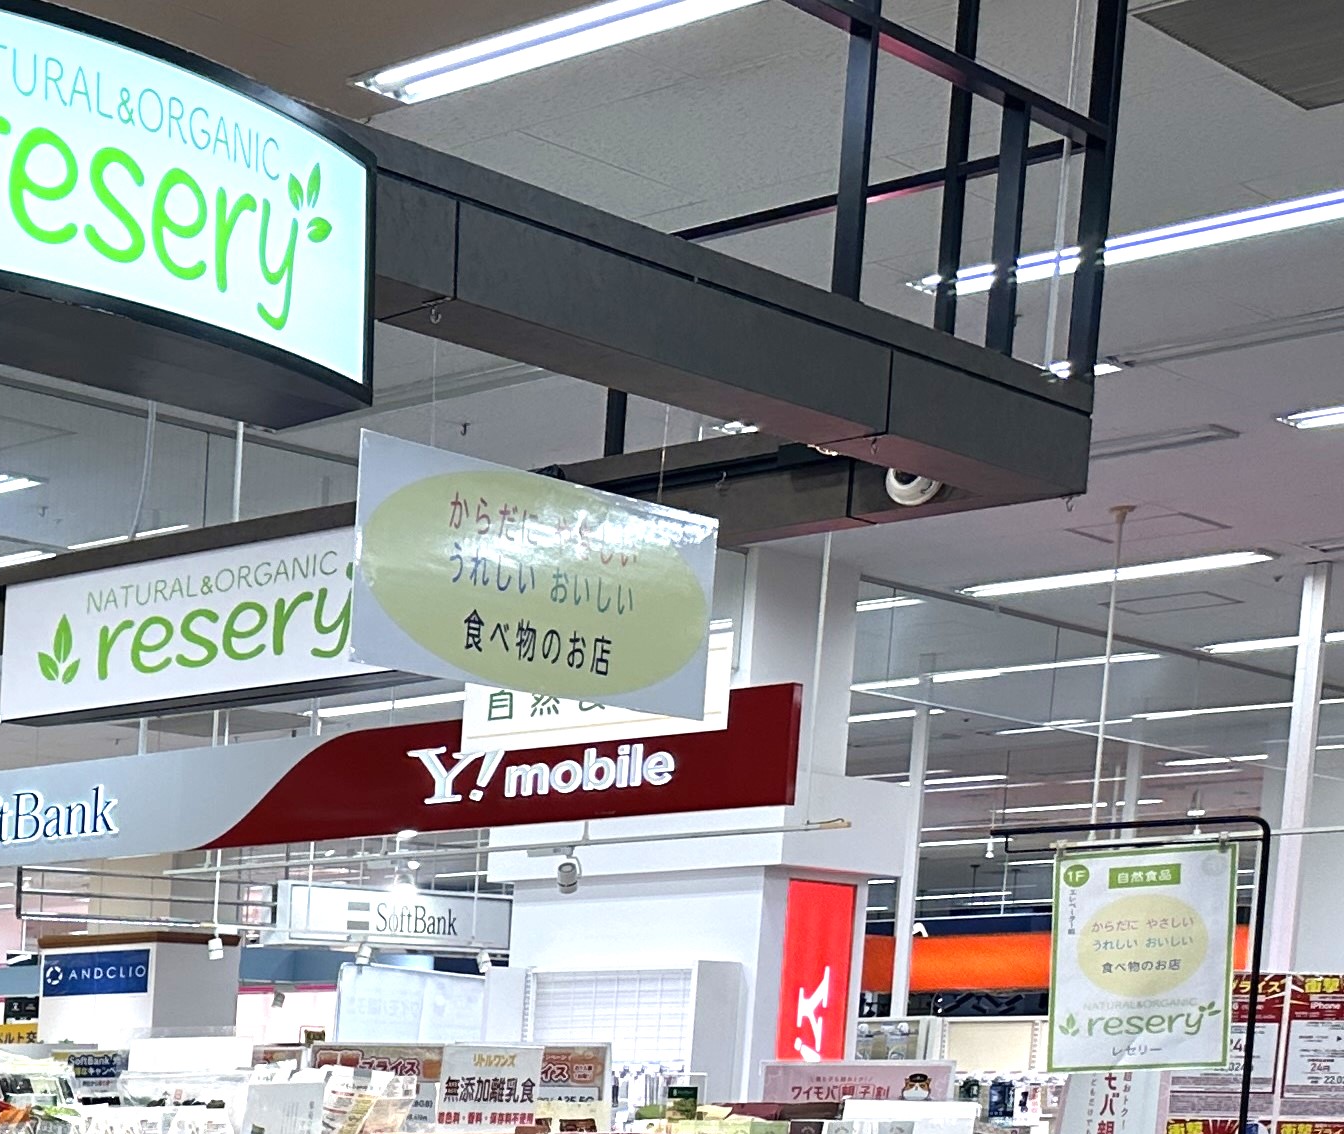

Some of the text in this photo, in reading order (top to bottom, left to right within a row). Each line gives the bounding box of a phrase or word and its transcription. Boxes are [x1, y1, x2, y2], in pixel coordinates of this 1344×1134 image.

[449, 491, 538, 545] からだに
[85, 549, 339, 614] NATURAL&ORGANIC
[449, 541, 634, 615] うれしい おいしい
[96, 586, 353, 682] resery
[463, 608, 613, 677] 食べ物のお店
[409, 743, 675, 806] Y!mobile
[1066, 869, 1087, 882] 1F
[1117, 868, 1172, 884] 自然食品
[375, 902, 459, 937] SoftBank
[1091, 916, 1194, 933] からだに やさしい
[1092, 935, 1194, 951] うれしい おいしい
[68, 963, 147, 982] ANDCLIO
[1101, 958, 1181, 974] 食べ物のお店
[1086, 1010, 1205, 1037] resery
[1112, 1044, 1163, 1057] レセリー
[443, 1076, 537, 1104] 無添加離乳食
[791, 1085, 891, 1101] ワイモバ親子割
